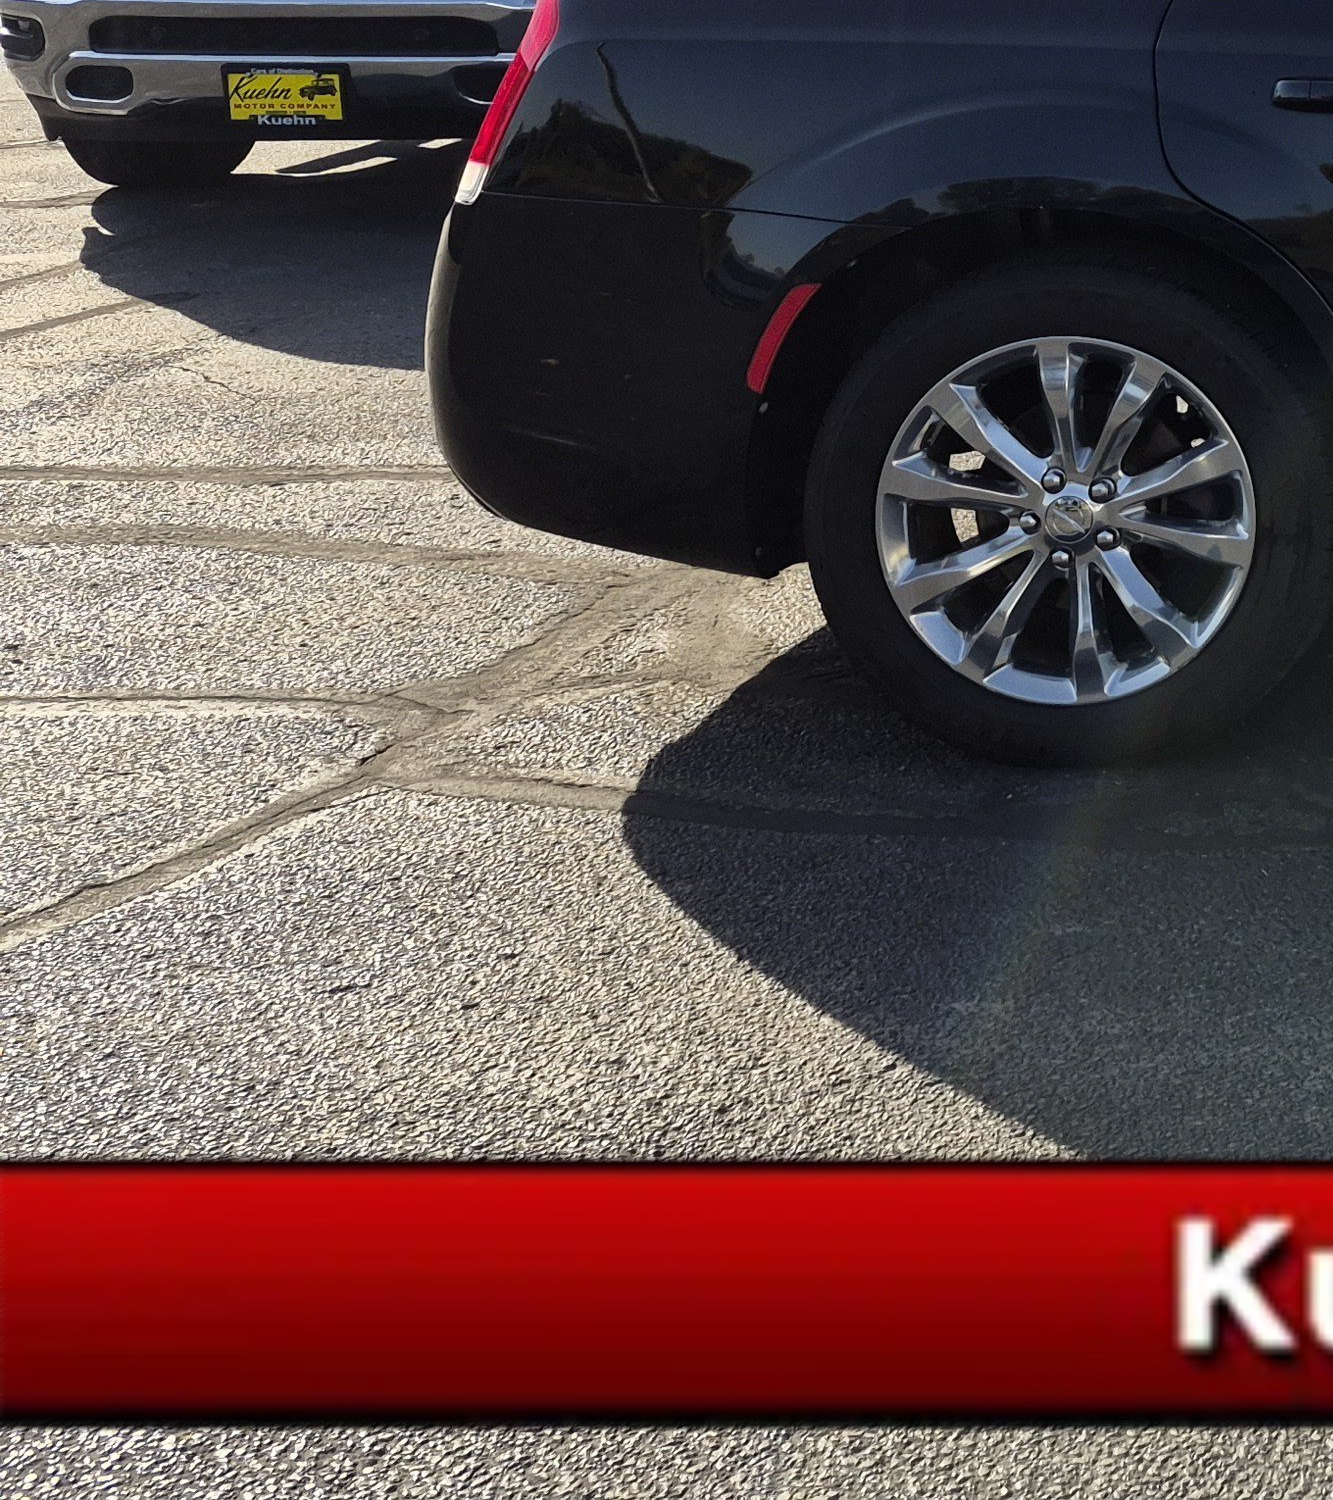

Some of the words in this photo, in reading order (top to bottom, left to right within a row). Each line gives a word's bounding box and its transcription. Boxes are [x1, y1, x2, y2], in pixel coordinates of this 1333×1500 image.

[228, 75, 293, 103] Kuehn
[233, 102, 276, 110] MOTOR
[279, 102, 337, 110] COMPANY
[257, 114, 317, 126] Kuehn
